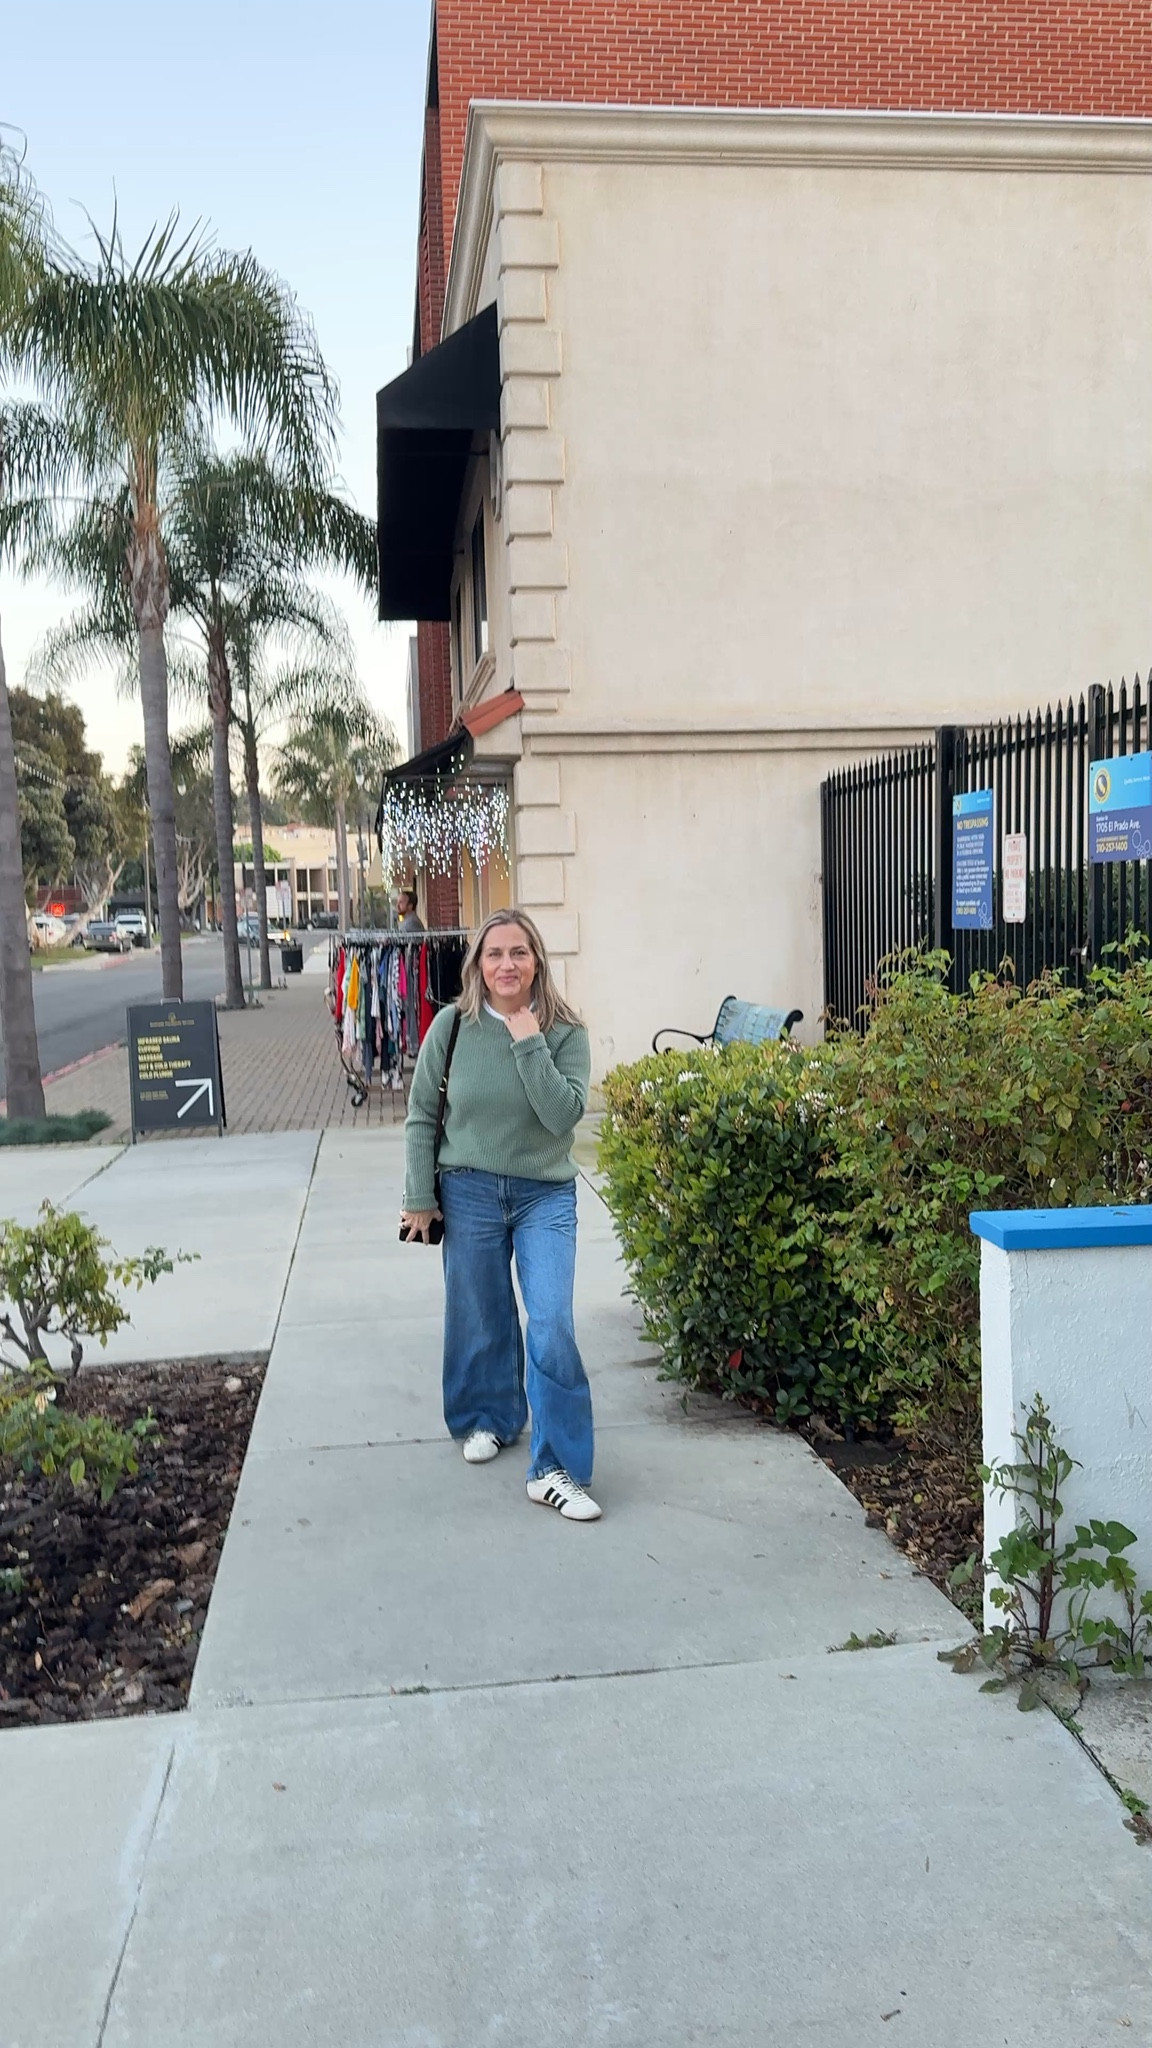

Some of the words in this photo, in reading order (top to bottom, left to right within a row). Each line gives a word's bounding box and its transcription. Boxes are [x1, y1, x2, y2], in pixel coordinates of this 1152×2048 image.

[1096, 822, 1108, 833] 1705
[1114, 820, 1128, 831] Prado
[1129, 819, 1141, 829] Ave.
